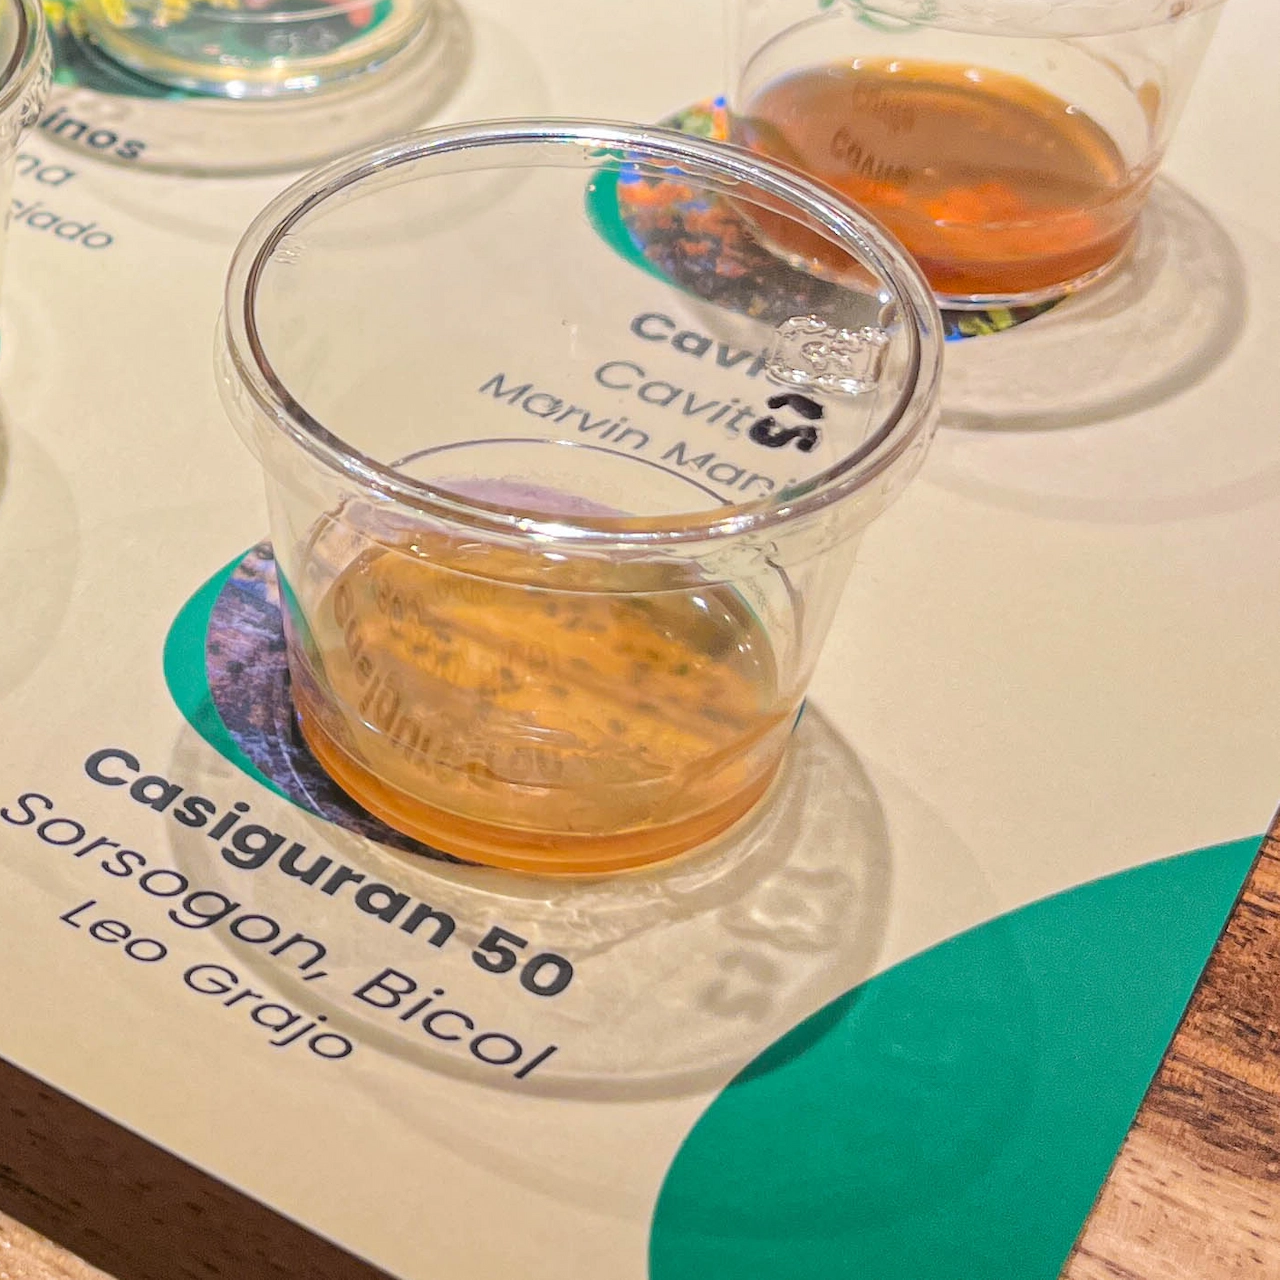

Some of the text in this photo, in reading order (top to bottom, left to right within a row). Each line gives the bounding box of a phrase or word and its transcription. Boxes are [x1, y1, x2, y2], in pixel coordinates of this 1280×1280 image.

[477, 371, 651, 452] Marvin
[0, 792, 560, 1080] Sorsogon, Bicol
[83, 747, 575, 998] Casiguran 50
[58, 899, 354, 1060] Leo Grajo
